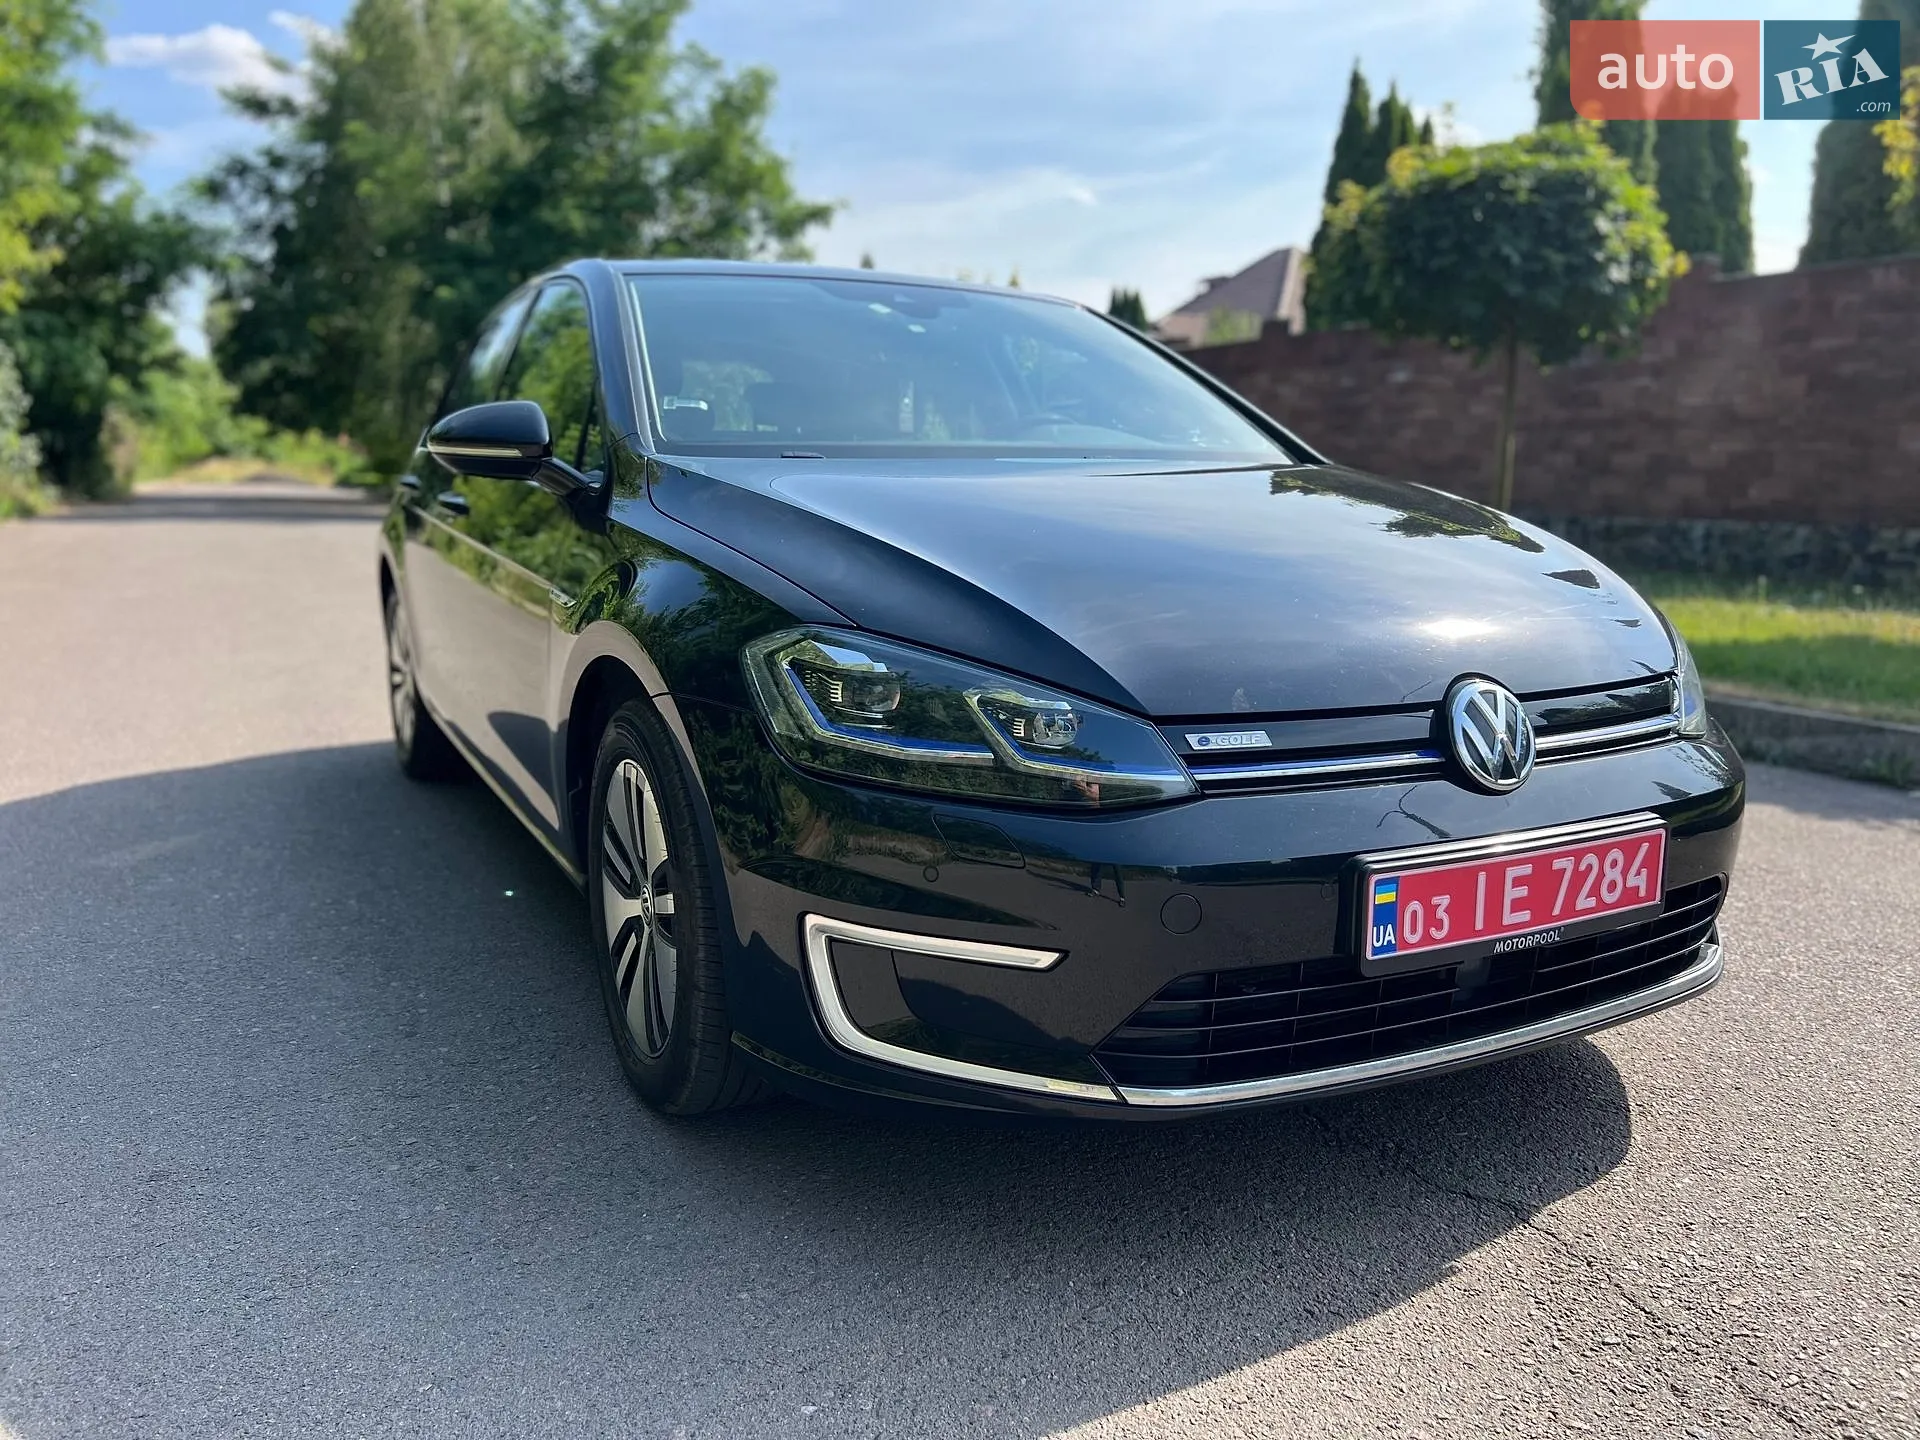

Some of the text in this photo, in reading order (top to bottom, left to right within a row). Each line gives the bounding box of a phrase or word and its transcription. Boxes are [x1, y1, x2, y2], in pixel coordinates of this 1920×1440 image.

[1403, 842, 1650, 944] 03 IE 7284
[1372, 922, 1396, 948] UA
[1493, 929, 1560, 954] MOTORPOOL
